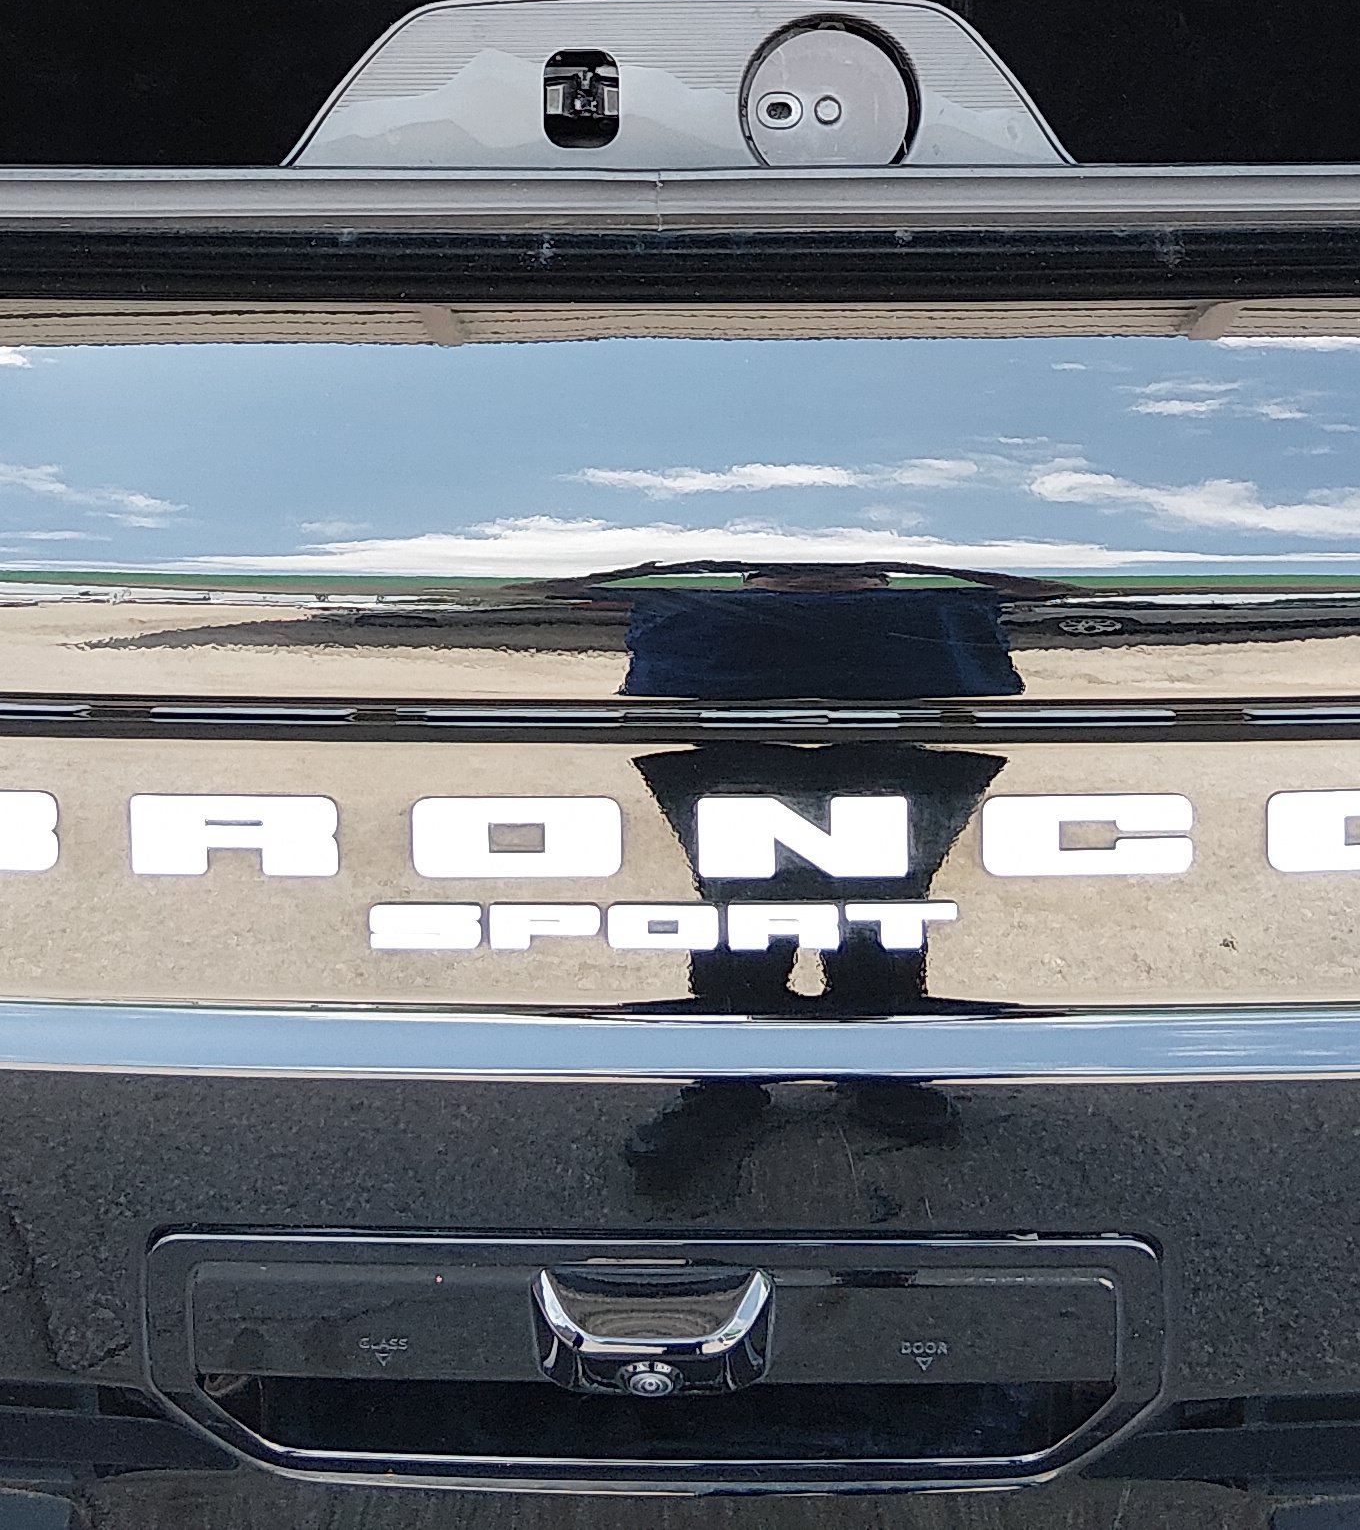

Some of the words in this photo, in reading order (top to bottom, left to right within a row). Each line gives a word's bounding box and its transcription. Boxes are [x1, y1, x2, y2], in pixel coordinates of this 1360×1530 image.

[368, 899, 960, 951] SPORT
[359, 1336, 409, 1351] GLASS
[900, 1340, 949, 1355] DOOR
